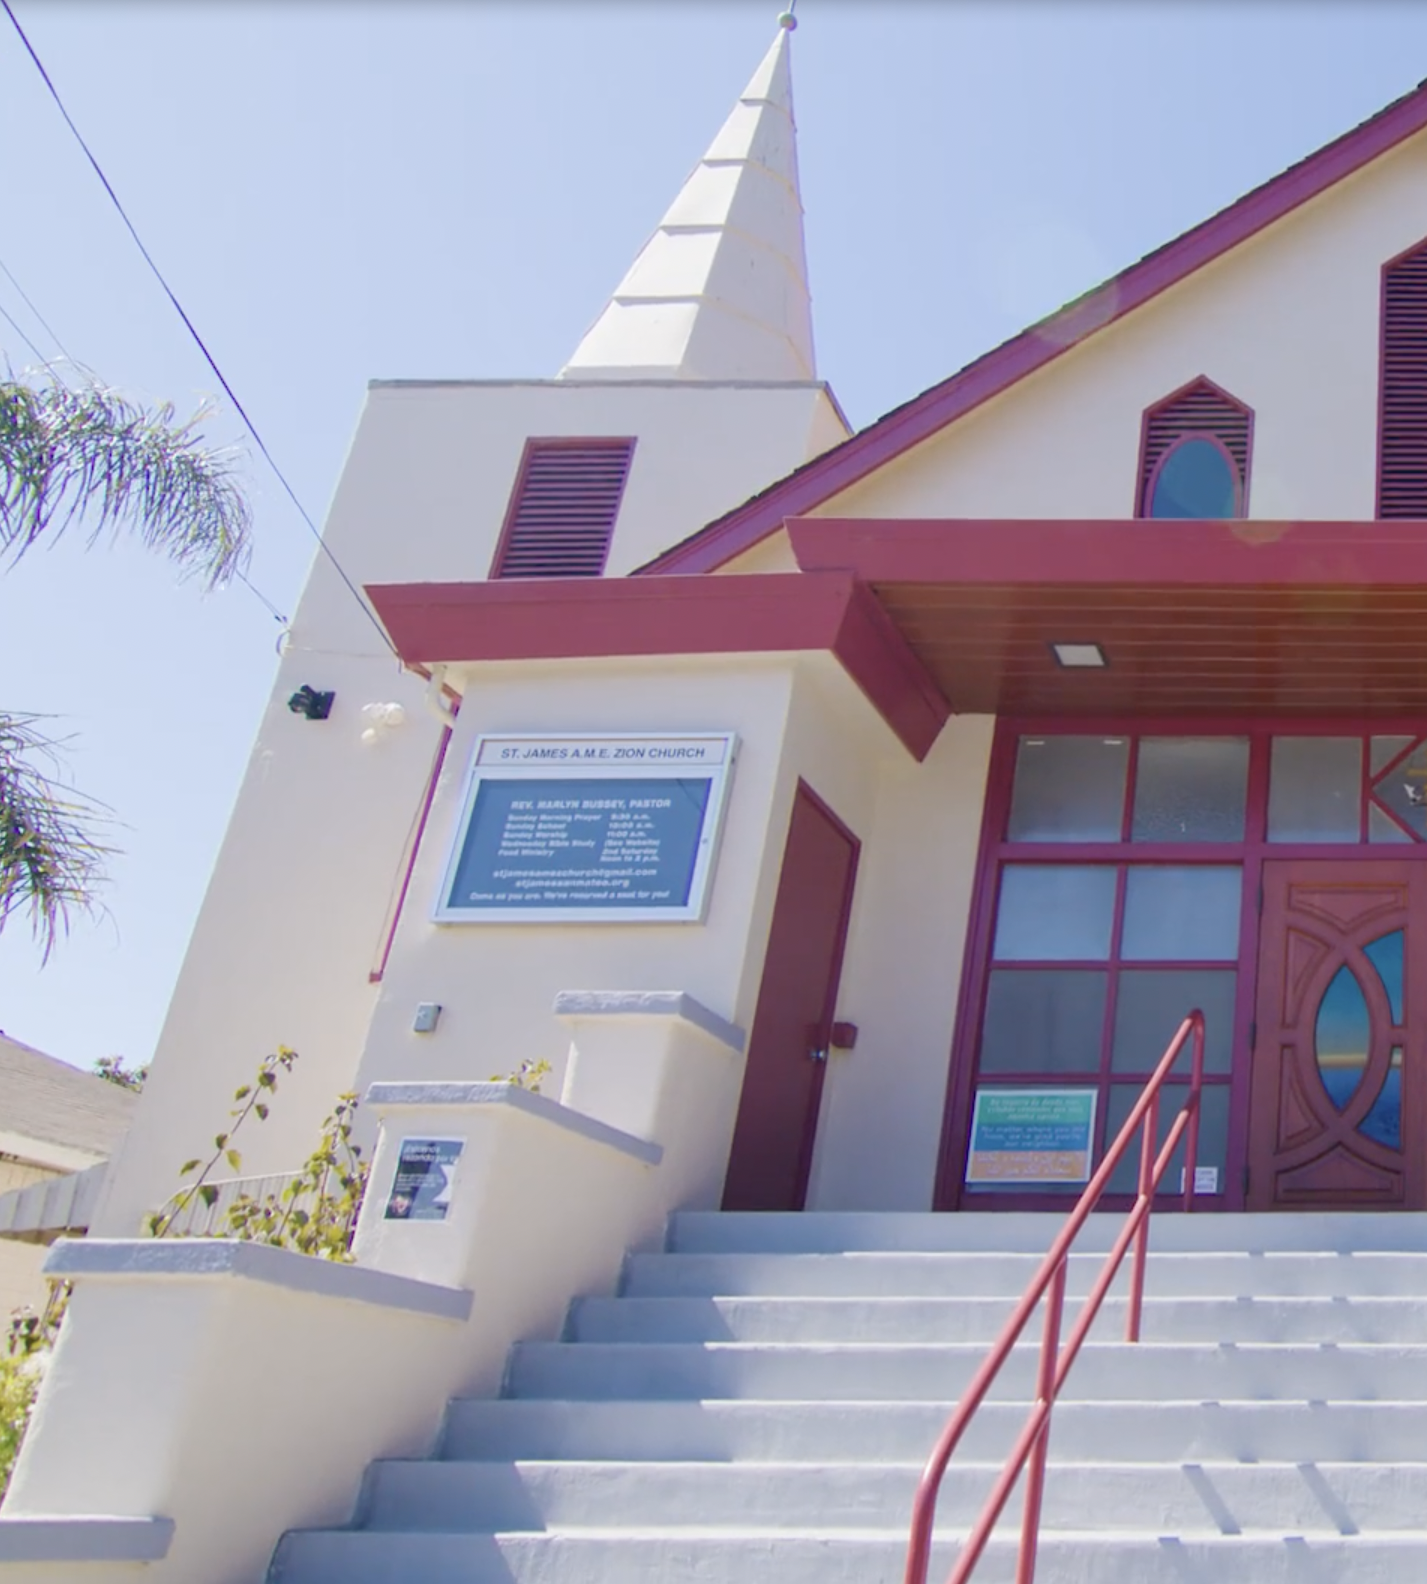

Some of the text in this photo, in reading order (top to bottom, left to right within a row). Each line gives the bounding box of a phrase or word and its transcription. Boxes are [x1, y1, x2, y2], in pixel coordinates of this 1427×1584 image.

[501, 747, 705, 759] ST. JAMES A.M.E. ZION CHURCH
[511, 799, 671, 810] REV. MARLYN BUSSEY, PASTOR
[508, 813, 538, 822] Sunday
[540, 814, 572, 823] Morning
[574, 814, 602, 822] Prayer
[505, 823, 535, 831] Sunday
[537, 822, 567, 830] School
[503, 831, 533, 840] Sunday
[535, 831, 568, 839] Worship
[501, 840, 547, 849] Wednesday
[549, 840, 570, 848] Bible
[572, 840, 596, 849] Study
[498, 849, 519, 857] Food
[521, 848, 555, 858] Ministry
[620, 847, 659, 856] Saturday
[470, 891, 494, 900] Come
[508, 893, 523, 902] you
[637, 890, 650, 898] for
